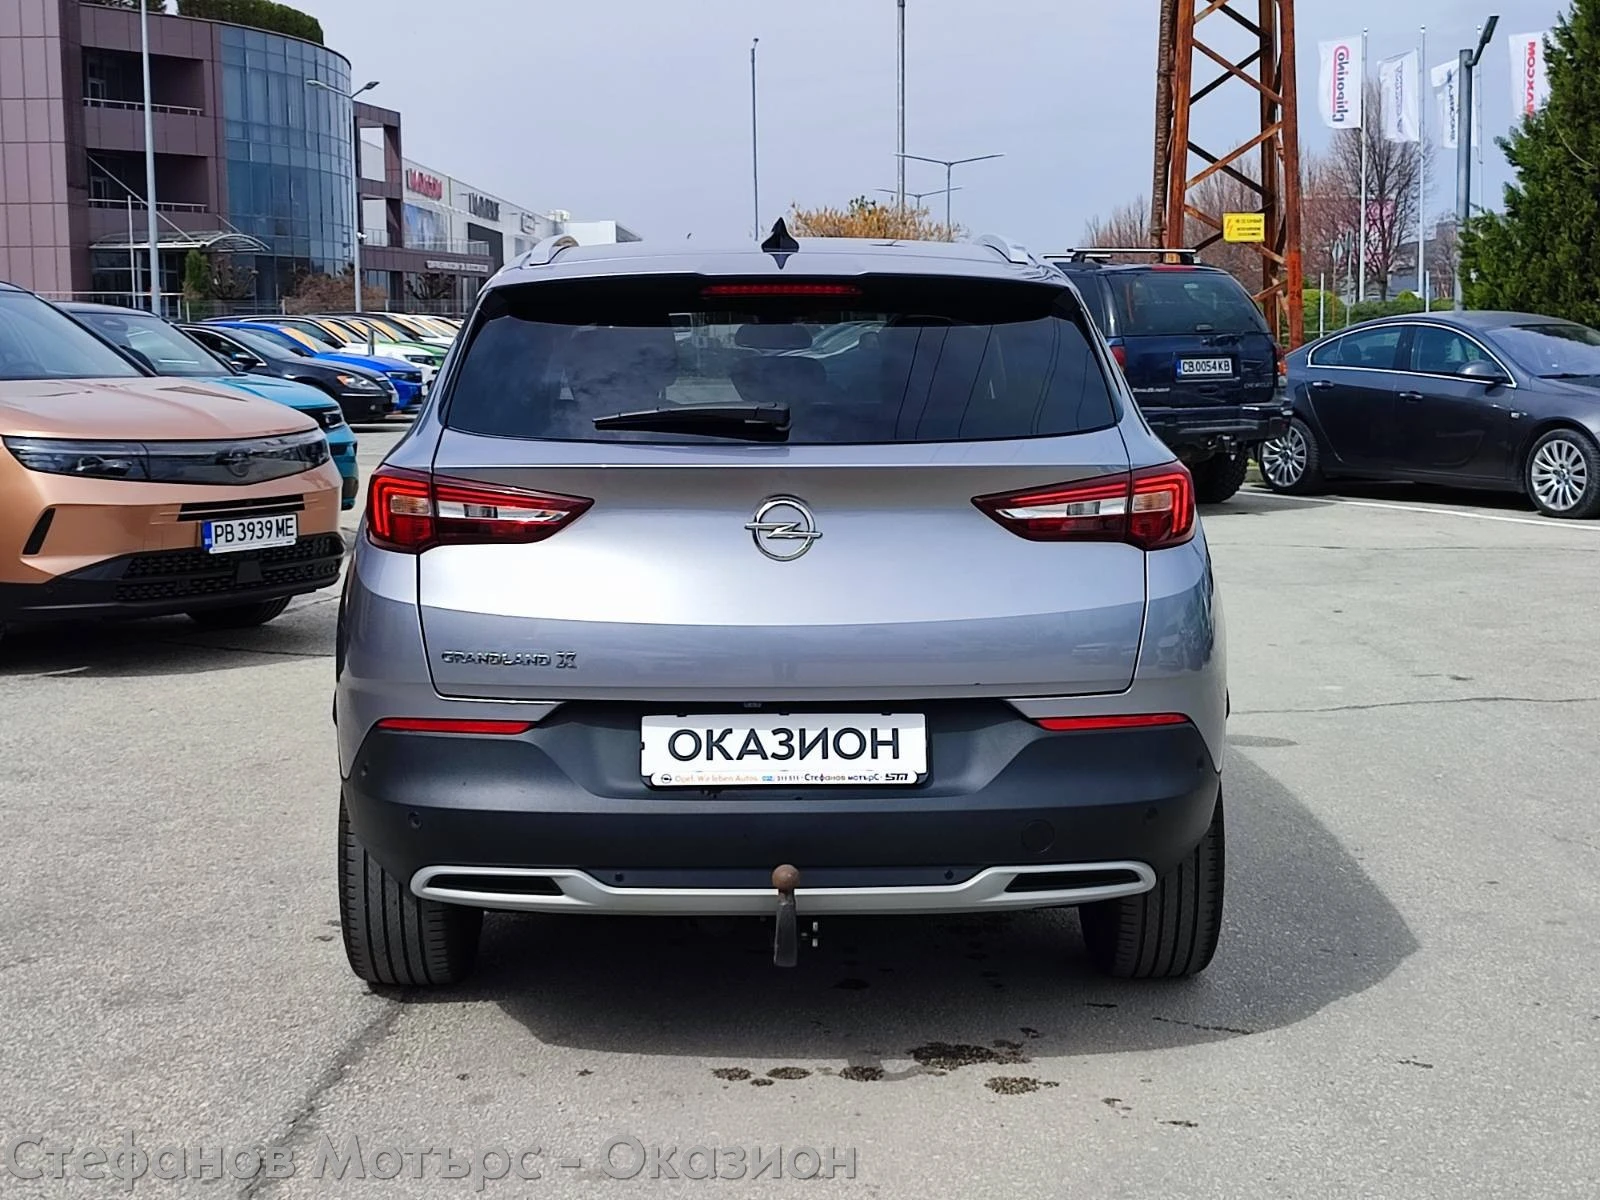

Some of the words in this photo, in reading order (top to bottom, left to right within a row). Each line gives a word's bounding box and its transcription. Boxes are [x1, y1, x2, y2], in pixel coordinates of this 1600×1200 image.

[214, 523, 235, 544] PB
[237, 519, 273, 541] 3939
[275, 517, 295, 538] ME
[441, 650, 551, 666] GRANDLAND
[555, 651, 577, 668] X
[668, 727, 900, 761] ОКАЗИОН
[804, 773, 846, 782] Стефанов
